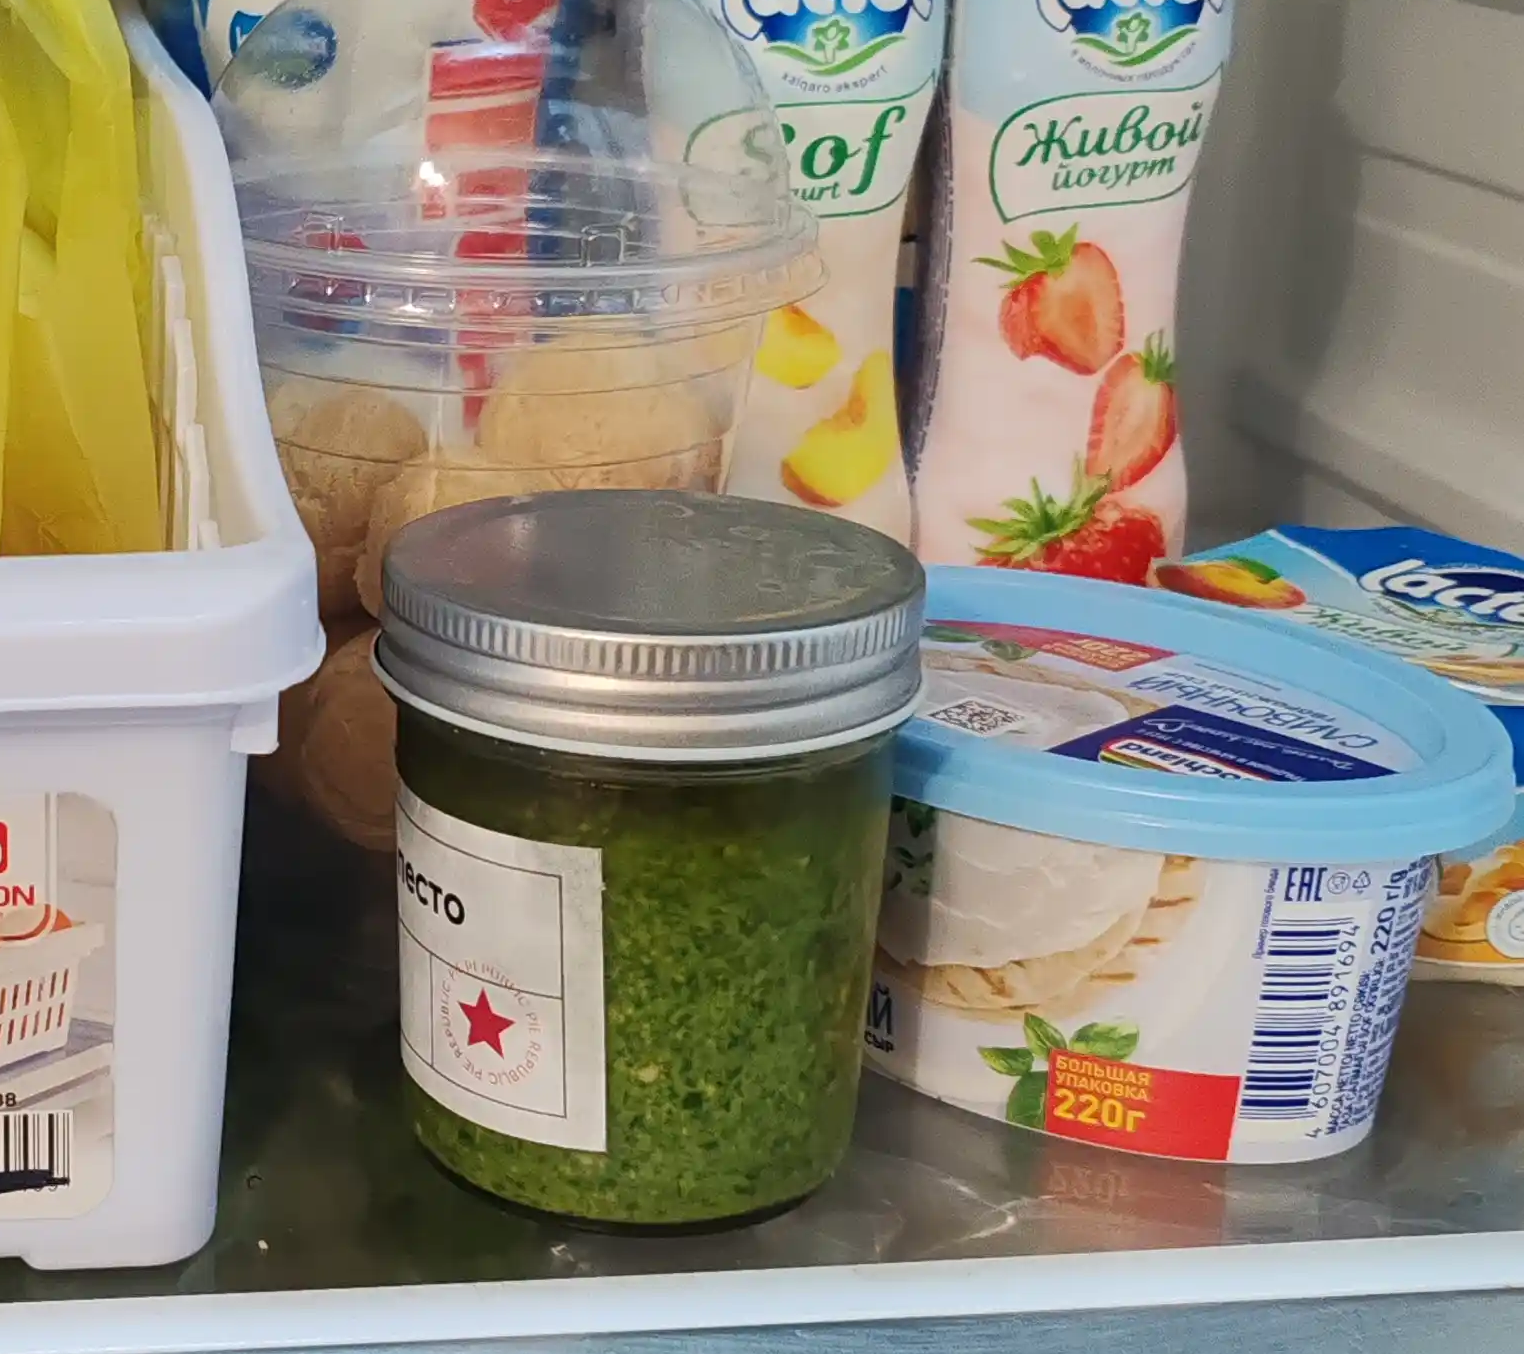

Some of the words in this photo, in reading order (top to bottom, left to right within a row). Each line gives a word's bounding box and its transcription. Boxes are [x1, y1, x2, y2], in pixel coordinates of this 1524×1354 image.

[1014, 101, 1204, 167] Живой
[1051, 155, 1177, 190] йогурт
[1126, 675, 1379, 749] СЛИВОЧНЫЙ
[1117, 741, 1243, 781] ochland
[1369, 906, 1396, 956] 220
[1309, 1024, 1343, 1109] 607004
[1327, 925, 1361, 1012] 891694
[1055, 1054, 1151, 1087] БОЛЬШАЯ
[1055, 1071, 1150, 1103] УПАКОВКА
